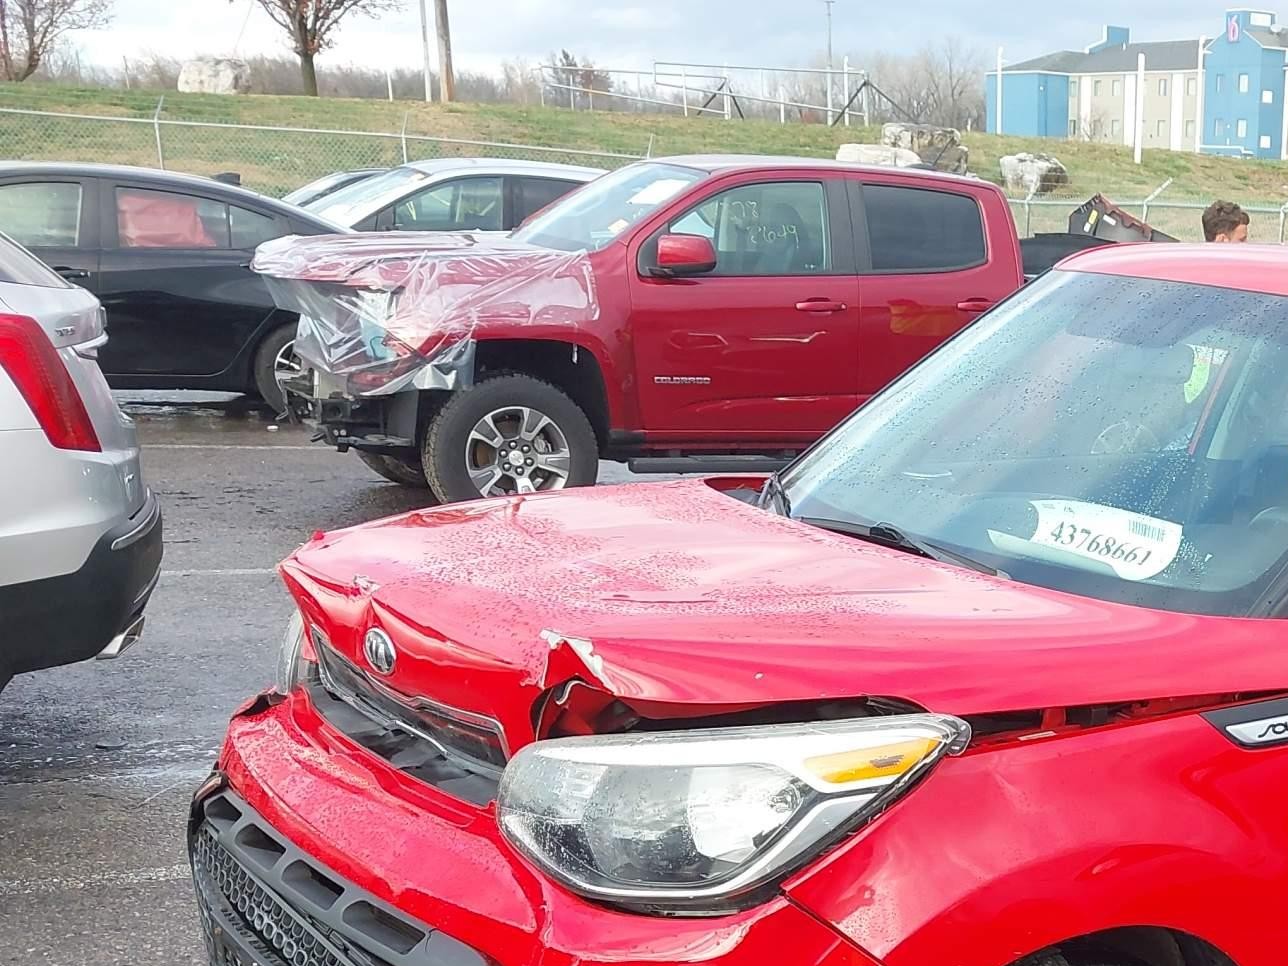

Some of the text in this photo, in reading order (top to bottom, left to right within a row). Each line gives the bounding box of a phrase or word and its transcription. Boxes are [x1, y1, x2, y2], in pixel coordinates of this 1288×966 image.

[1227, 14, 1239, 42] 6
[654, 376, 711, 385] COLORADO
[1050, 521, 1153, 566] 43768661
